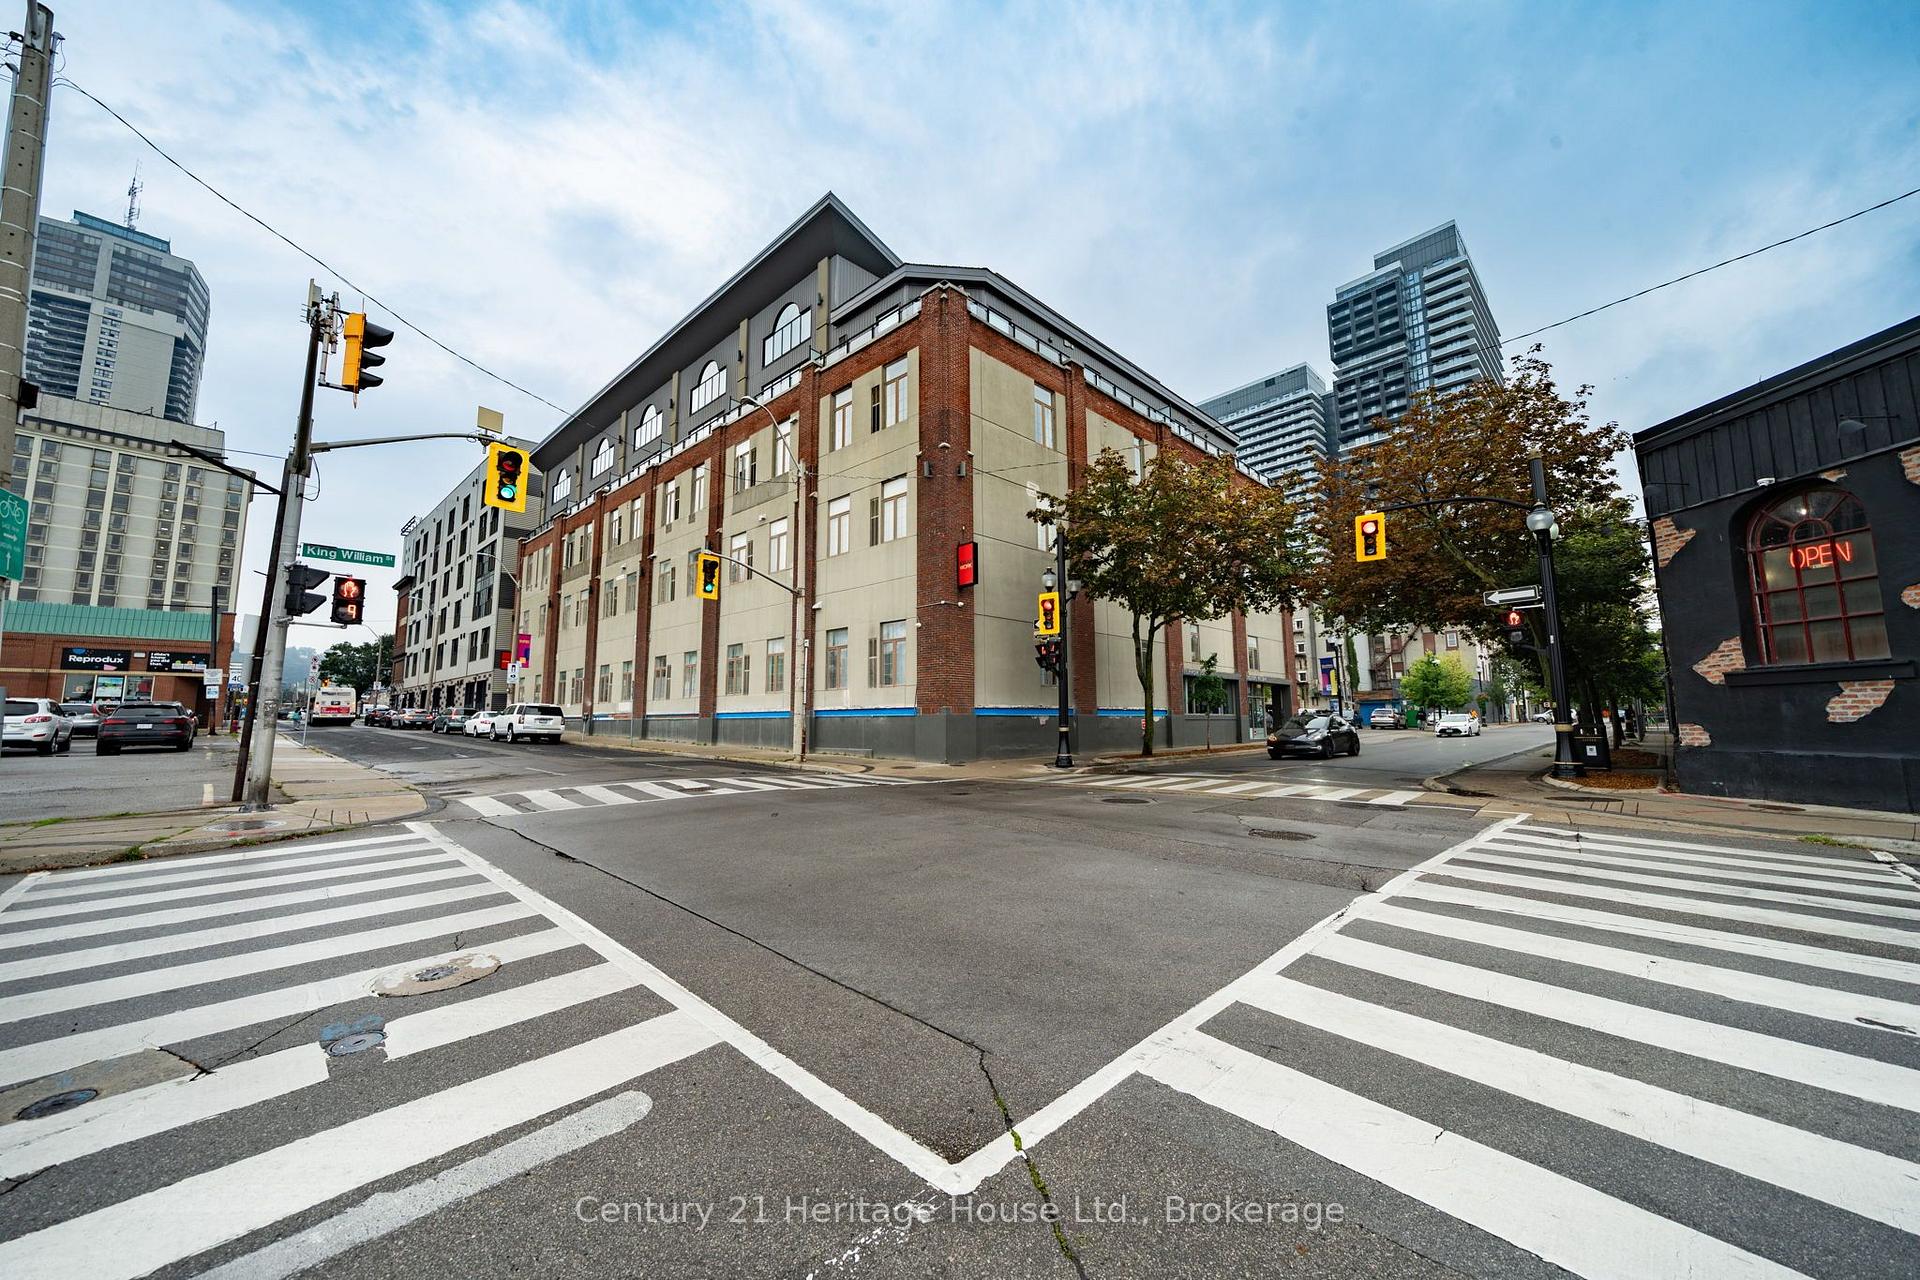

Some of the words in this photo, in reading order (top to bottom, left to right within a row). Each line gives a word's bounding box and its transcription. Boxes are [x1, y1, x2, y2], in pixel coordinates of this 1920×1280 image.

[307, 546, 337, 559] King
[341, 550, 383, 563] William
[1790, 541, 1851, 568] OPEN
[348, 604, 356, 618] 9
[68, 655, 124, 664] Reprodux
